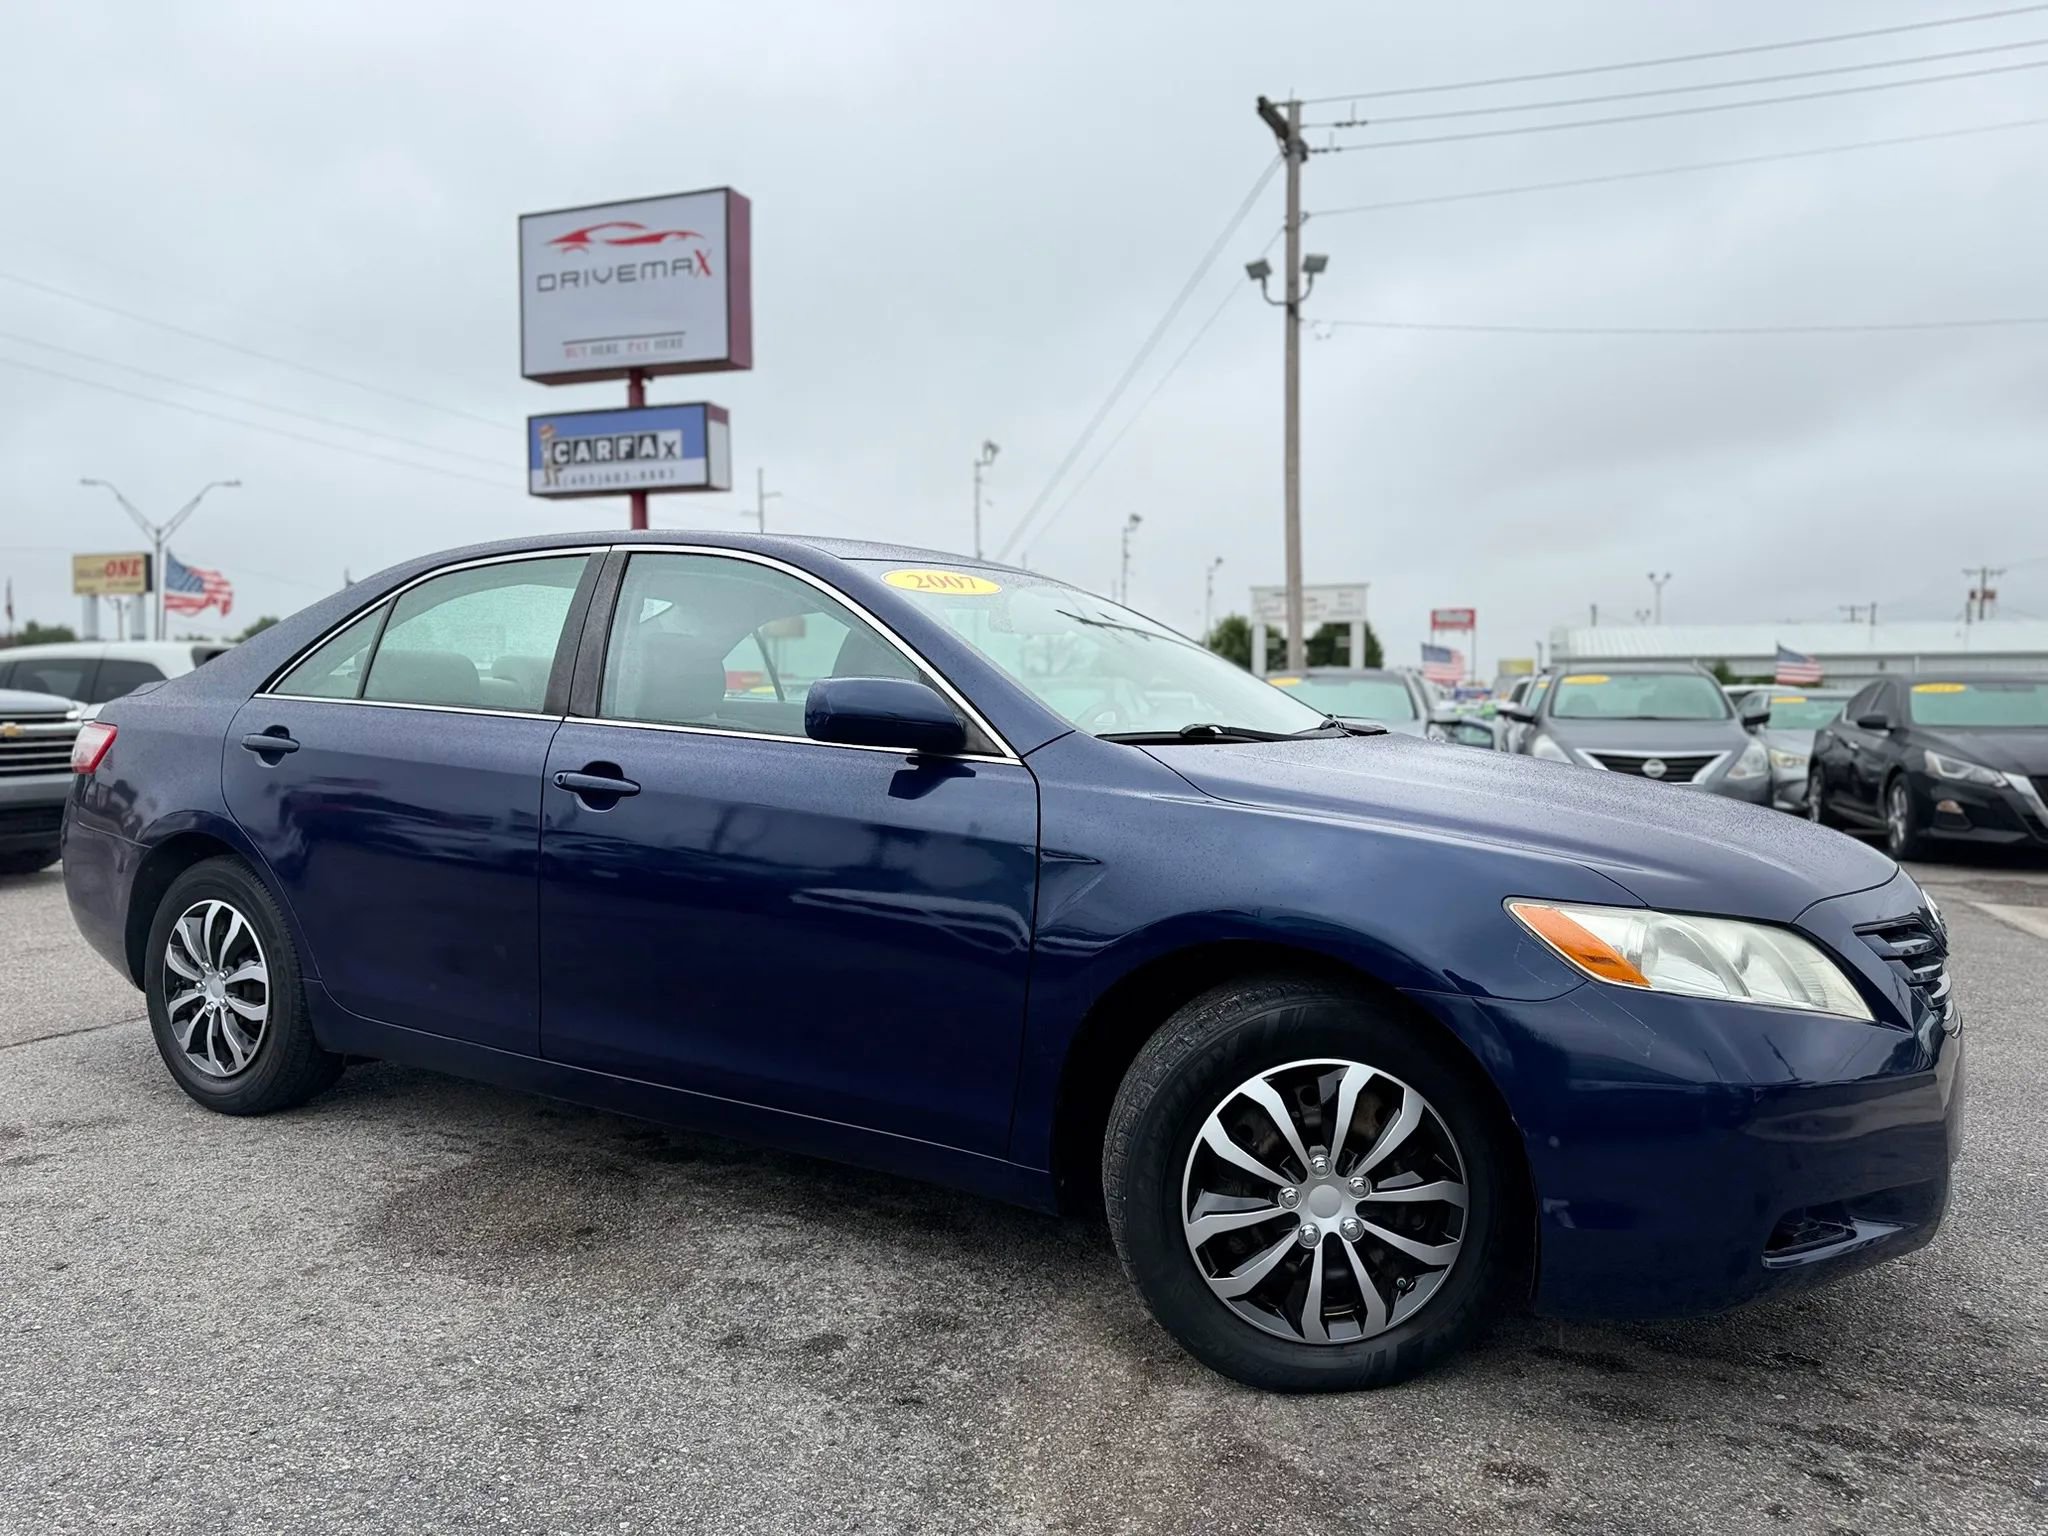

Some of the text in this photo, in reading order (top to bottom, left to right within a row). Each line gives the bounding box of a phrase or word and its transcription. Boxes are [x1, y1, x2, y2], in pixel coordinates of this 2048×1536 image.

[536, 248, 712, 293] DRIVEMAX
[554, 435, 678, 463] CARFAX
[105, 559, 142, 578] ONE
[906, 574, 977, 590] 2007
